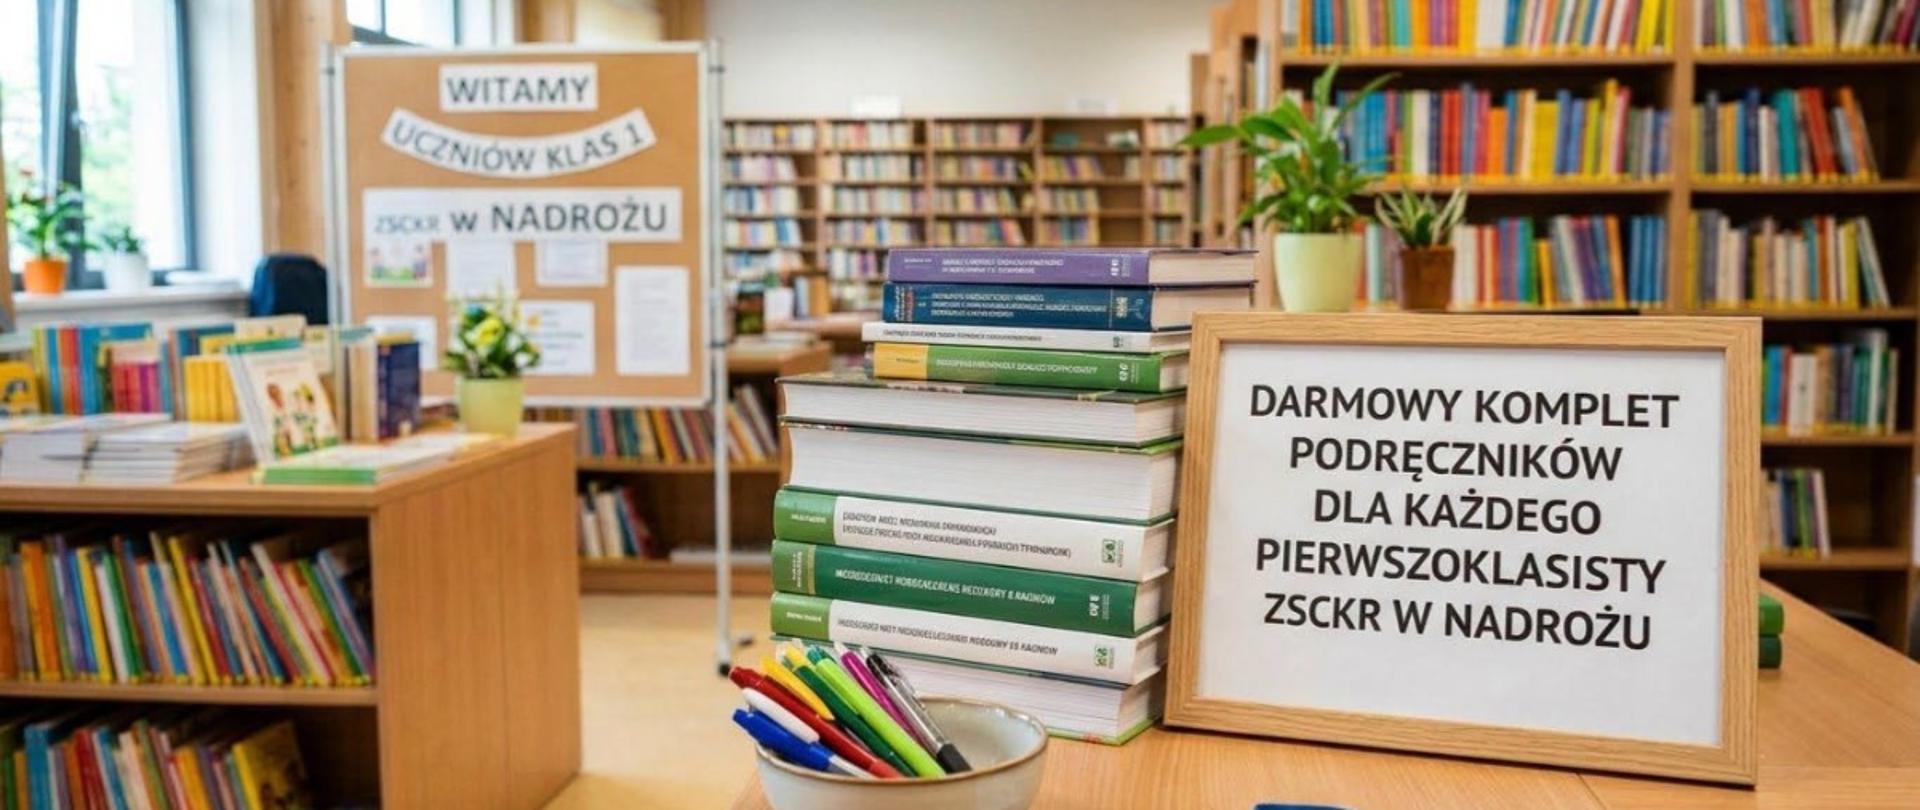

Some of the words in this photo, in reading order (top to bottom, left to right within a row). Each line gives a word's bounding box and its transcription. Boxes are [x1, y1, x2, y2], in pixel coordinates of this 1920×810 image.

[446, 77, 590, 104] WITAMY
[391, 117, 535, 172] UCZNIÓW
[546, 134, 618, 171] KLAS
[626, 123, 643, 147] 1
[491, 196, 667, 232] NADROŻU
[1249, 384, 1463, 423] DARMOWY
[1474, 390, 1680, 428] KOMPLET
[1289, 436, 1623, 483] PODRĘCZNIKÓW
[1313, 489, 1392, 525] DLA
[1403, 487, 1602, 536] KAŻDEGO
[1256, 538, 1666, 594] PIERWSZOKLASISTY
[1264, 592, 1381, 632] ZSCKR
[1392, 599, 1433, 635] W
[1444, 602, 1651, 650] NADROŻU
